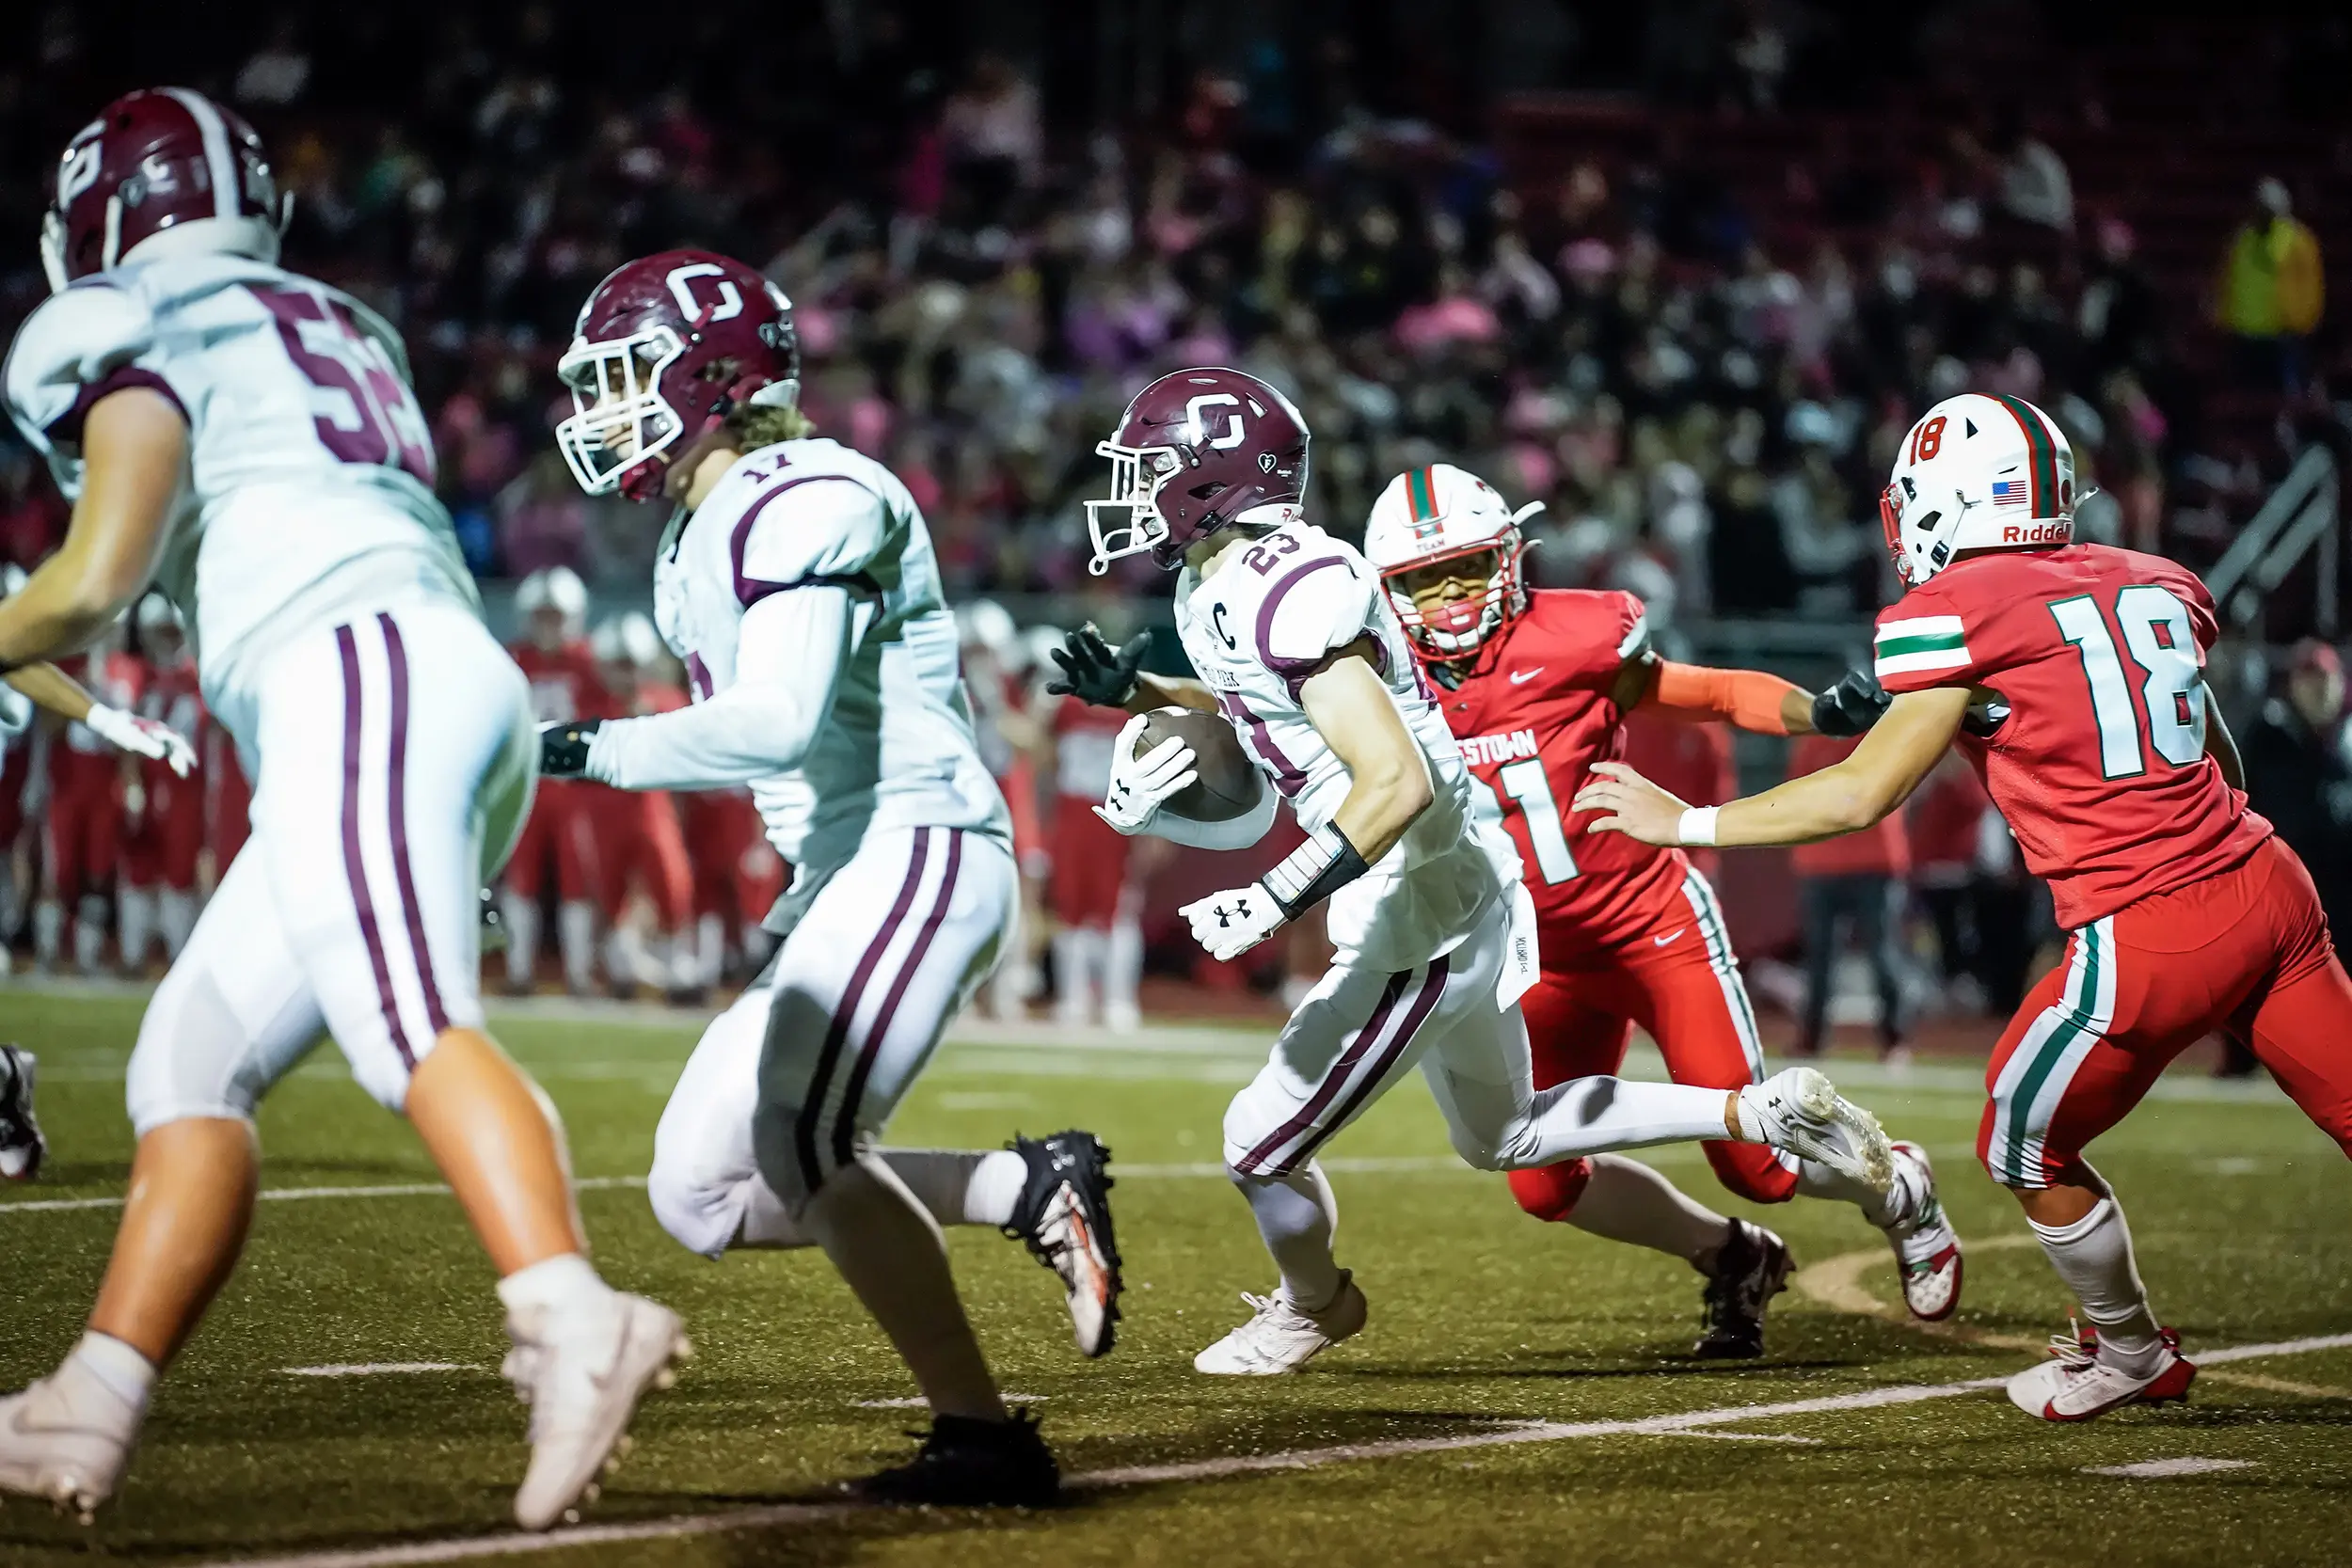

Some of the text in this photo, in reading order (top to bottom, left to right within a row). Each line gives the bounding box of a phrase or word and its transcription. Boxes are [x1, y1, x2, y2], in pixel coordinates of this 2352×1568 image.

[1909, 416, 1948, 467] 18
[1242, 533, 1300, 577] 23
[2003, 523, 2072, 543] Riddel
[1213, 602, 1236, 651] C
[2046, 583, 2207, 783] 18
